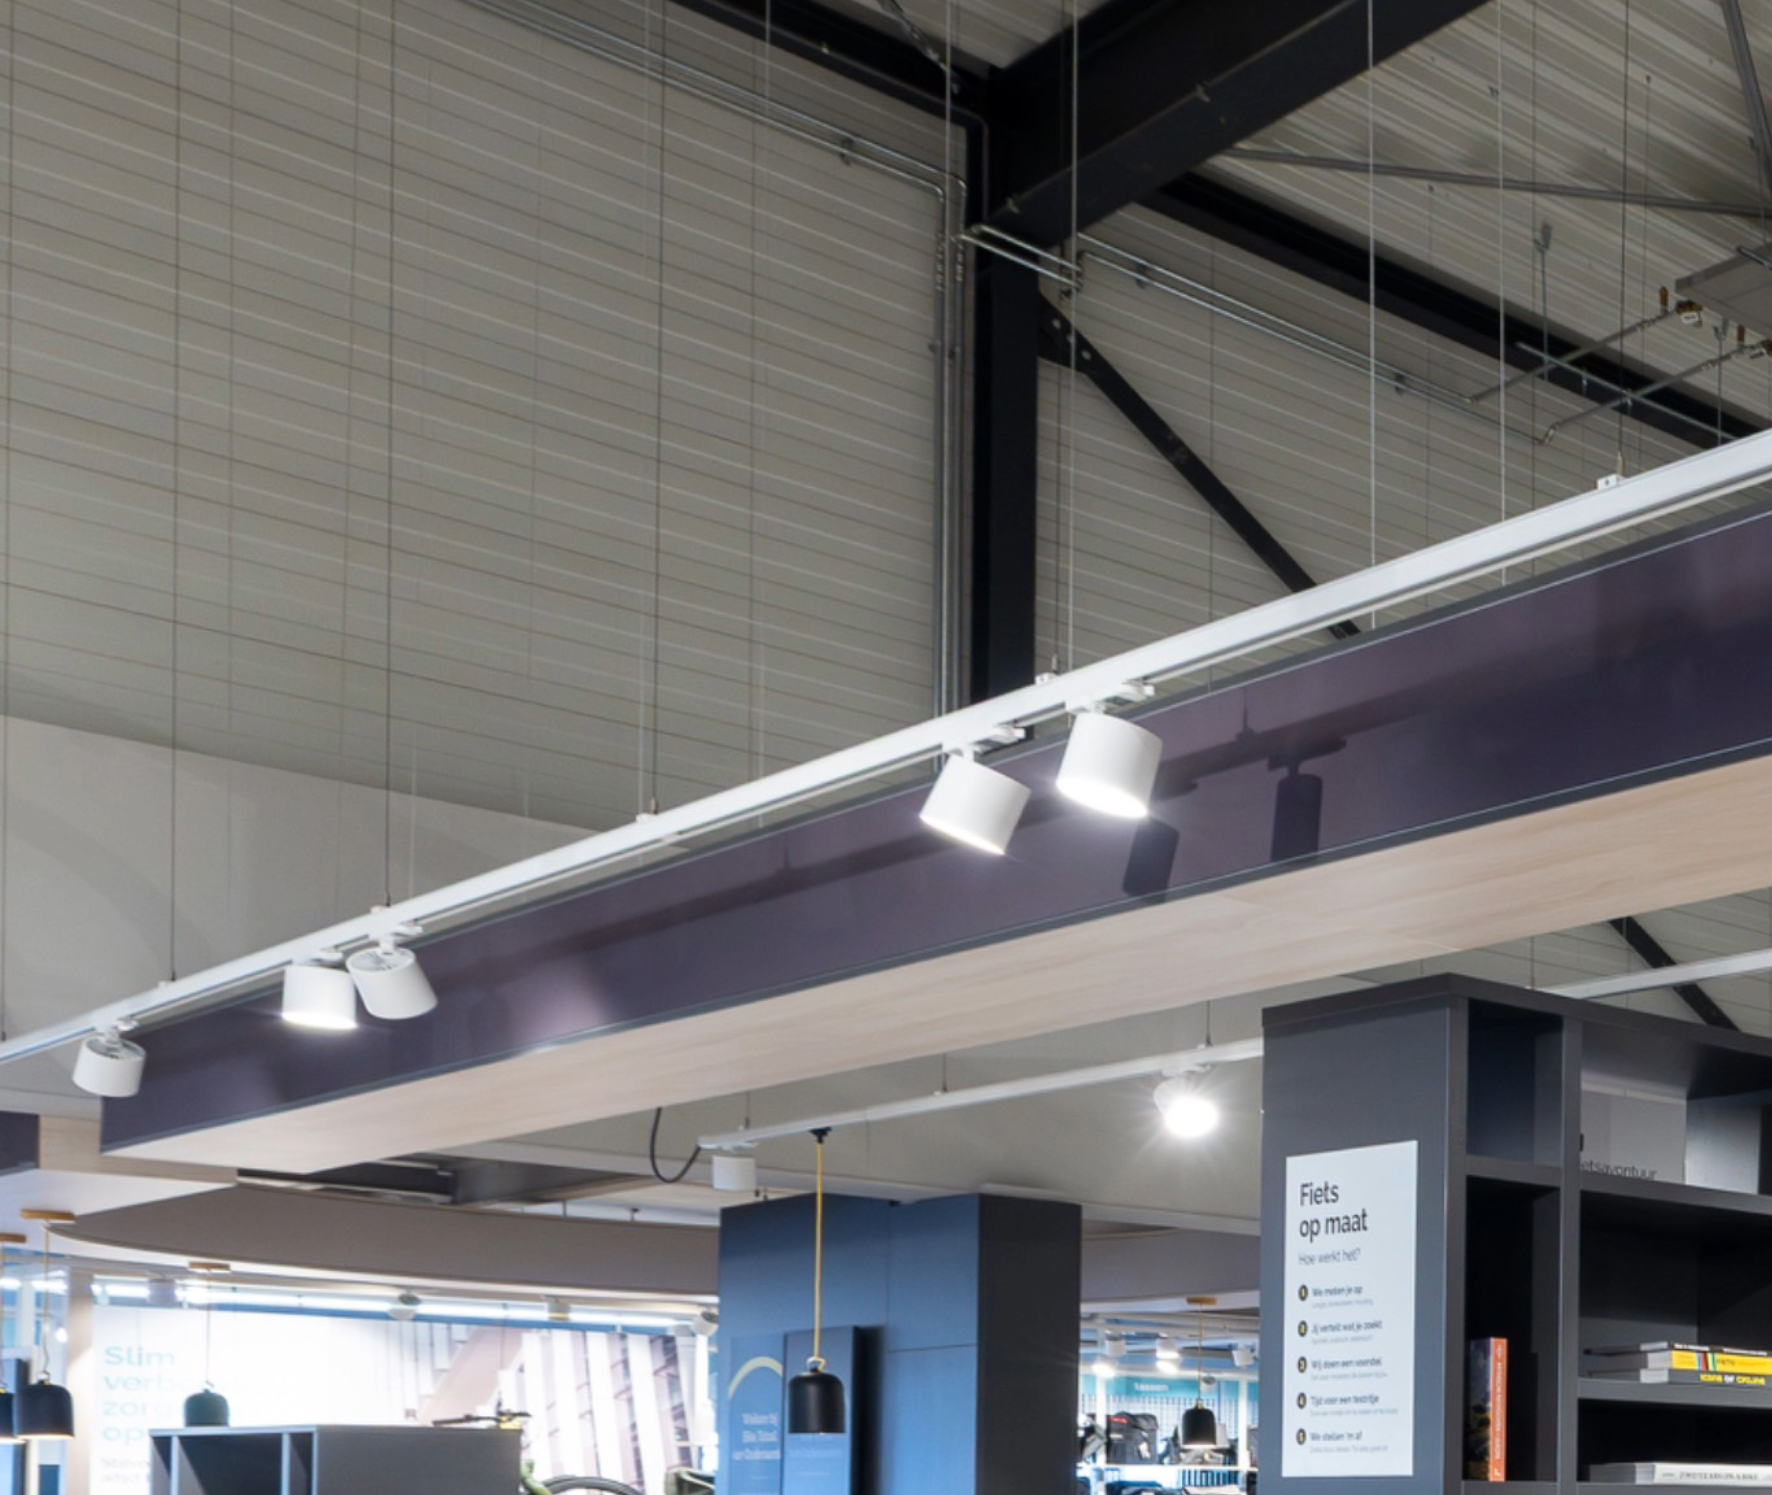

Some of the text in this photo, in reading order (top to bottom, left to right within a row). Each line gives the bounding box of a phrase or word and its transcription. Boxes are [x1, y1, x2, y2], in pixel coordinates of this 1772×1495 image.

[1300, 1181, 1339, 1206] Fiets
[1300, 1208, 1368, 1243] op maat
[1299, 1252, 1315, 1265] Hoe
[104, 1345, 176, 1366] Slim
